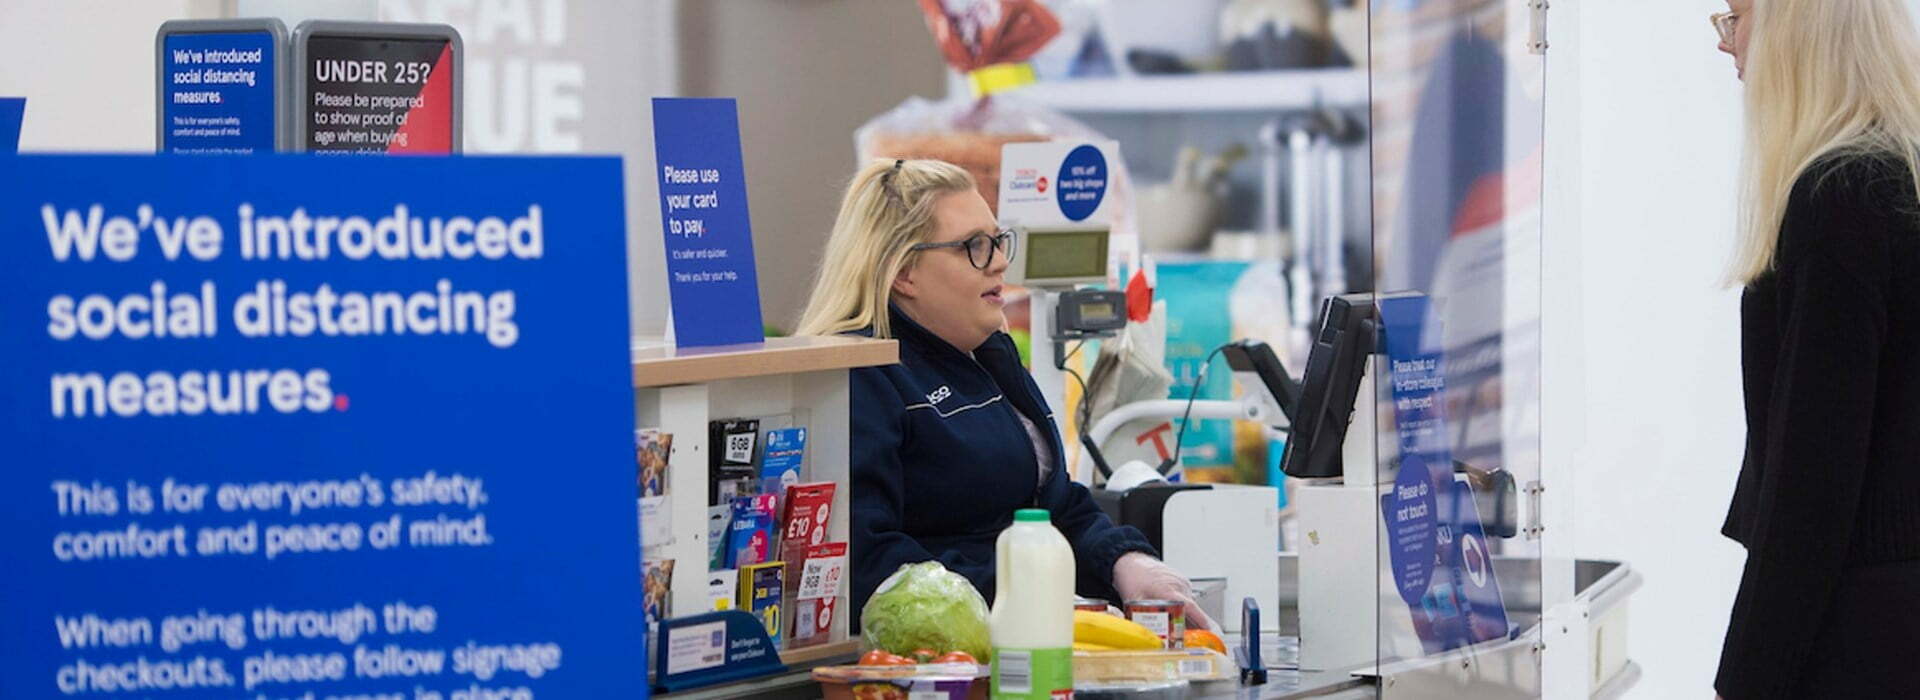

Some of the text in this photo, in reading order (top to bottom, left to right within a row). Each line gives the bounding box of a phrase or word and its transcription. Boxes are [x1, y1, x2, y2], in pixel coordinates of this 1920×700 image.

[174, 48, 261, 64] We've introduced
[174, 68, 255, 87] social distancing
[316, 60, 431, 84] UNDER 25?
[315, 92, 424, 110] Please be prepared
[315, 111, 409, 127] to show proof of
[315, 129, 408, 147] age when buying
[664, 166, 720, 184] Please use
[666, 190, 718, 213] your card
[41, 204, 543, 261] We've introduced
[669, 217, 708, 238] to pay.
[47, 278, 518, 348] social distancing
[50, 368, 349, 417] measures.
[53, 481, 117, 514] This
[127, 482, 153, 513] is
[162, 477, 207, 511] for
[216, 474, 384, 513] everyone's
[1398, 480, 1428, 500] Please do
[1397, 501, 1428, 522] not touch
[53, 514, 494, 560] comfort and peace of mind.
[788, 517, 810, 538] £10
[55, 601, 437, 652] When going through the
[244, 652, 347, 690] please
[354, 643, 444, 678] follow
[452, 641, 562, 680] signage
